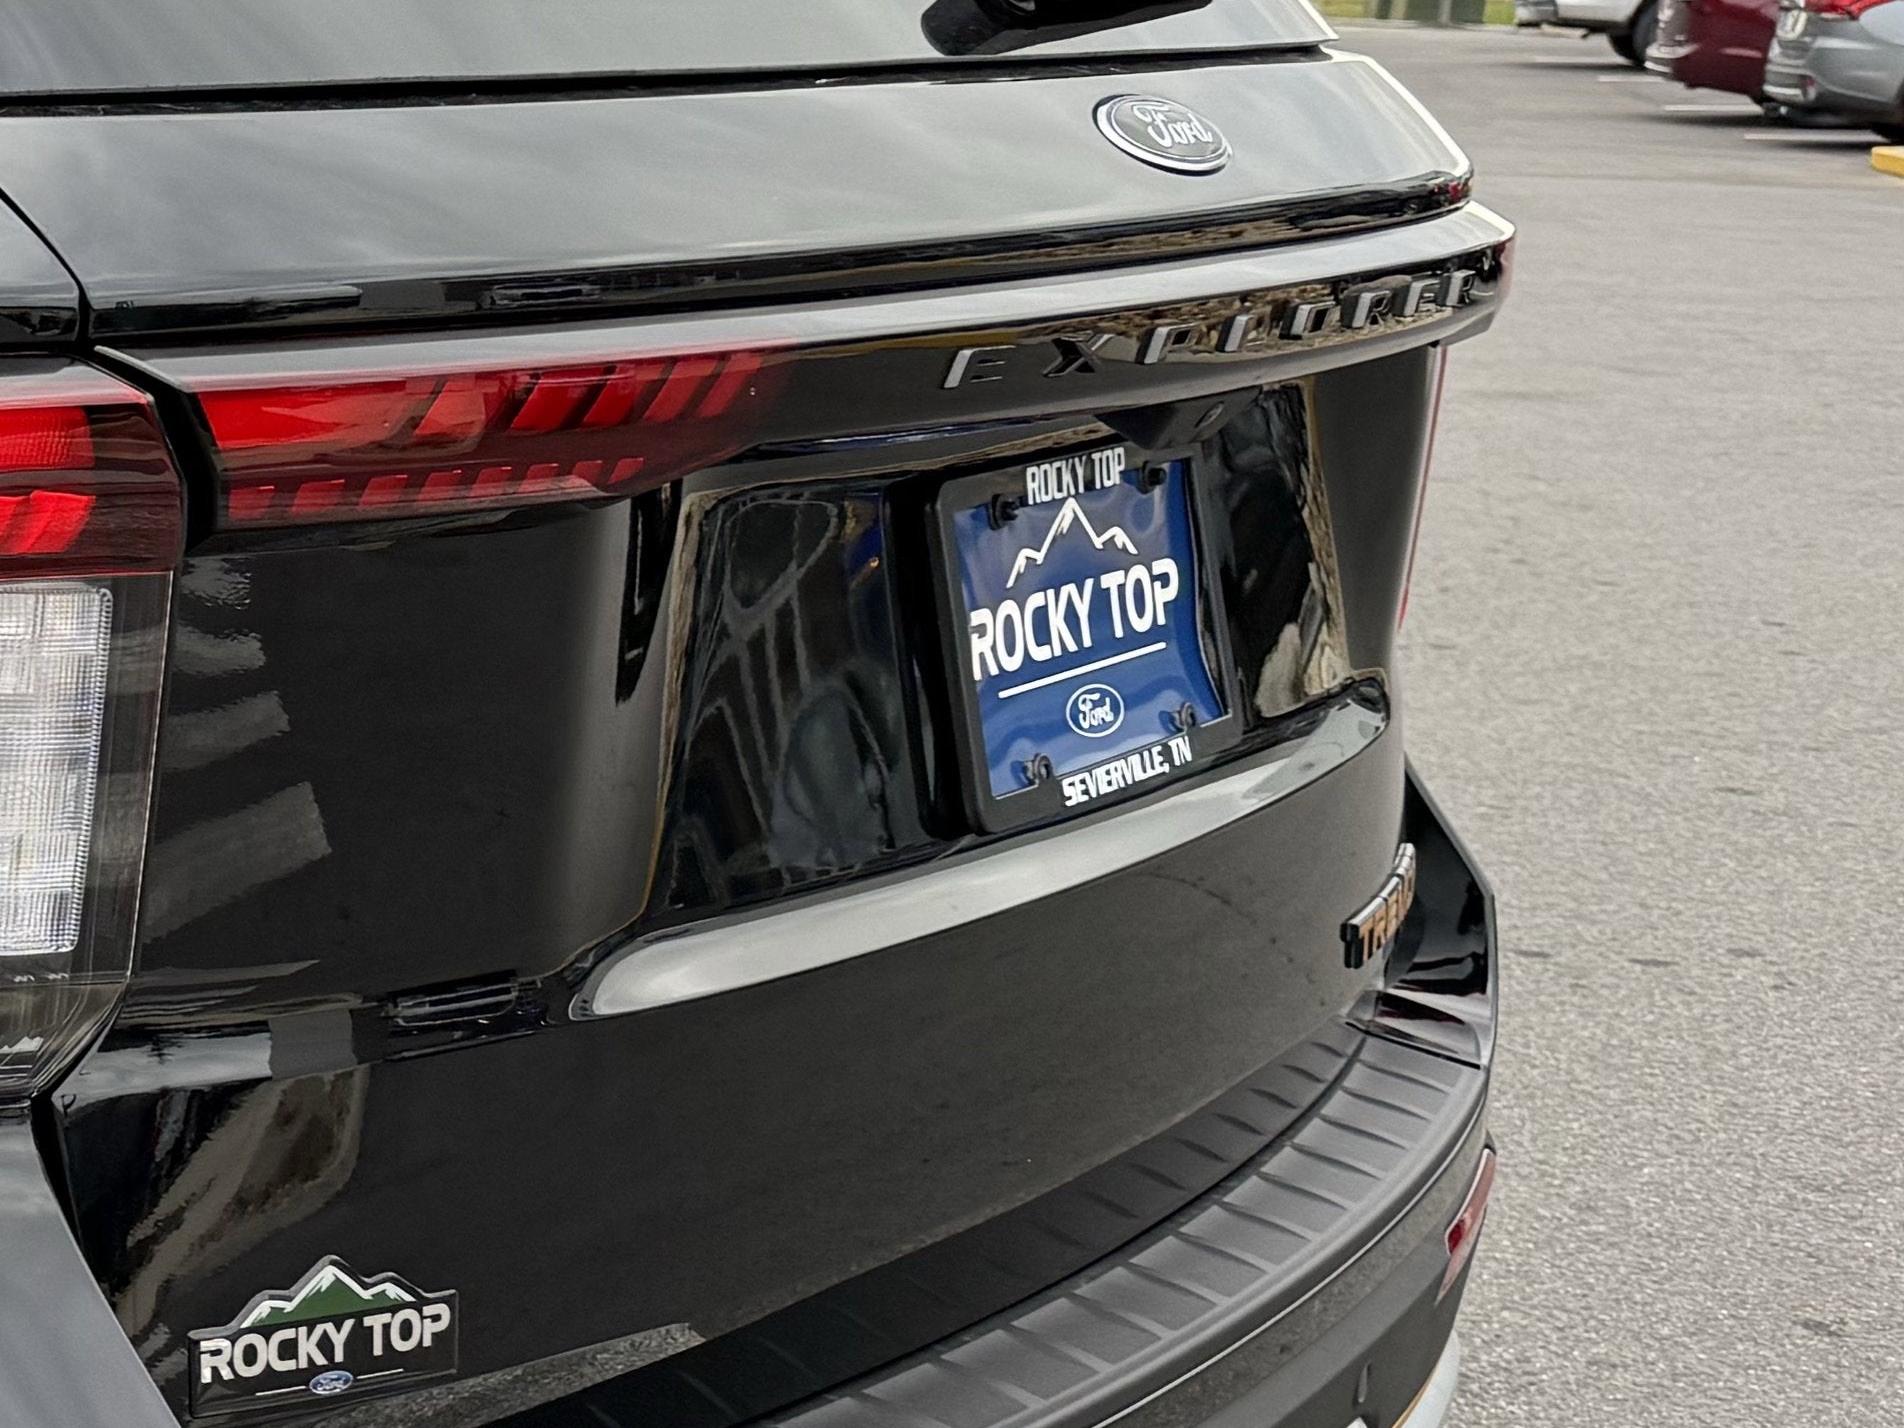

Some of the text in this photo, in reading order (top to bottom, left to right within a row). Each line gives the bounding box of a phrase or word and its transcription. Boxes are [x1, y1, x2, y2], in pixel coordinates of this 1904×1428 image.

[1136, 101, 1213, 148] Ford
[942, 269, 1477, 388] EXPLORER
[1026, 446, 1126, 505] ROCKY TOP
[969, 557, 1180, 682] ROCKY TOP
[1077, 692, 1115, 730] Ford
[1062, 735, 1193, 807] SEVIERVILLE, TN
[199, 1318, 356, 1384] ROCKY
[363, 1302, 452, 1356] TOP
